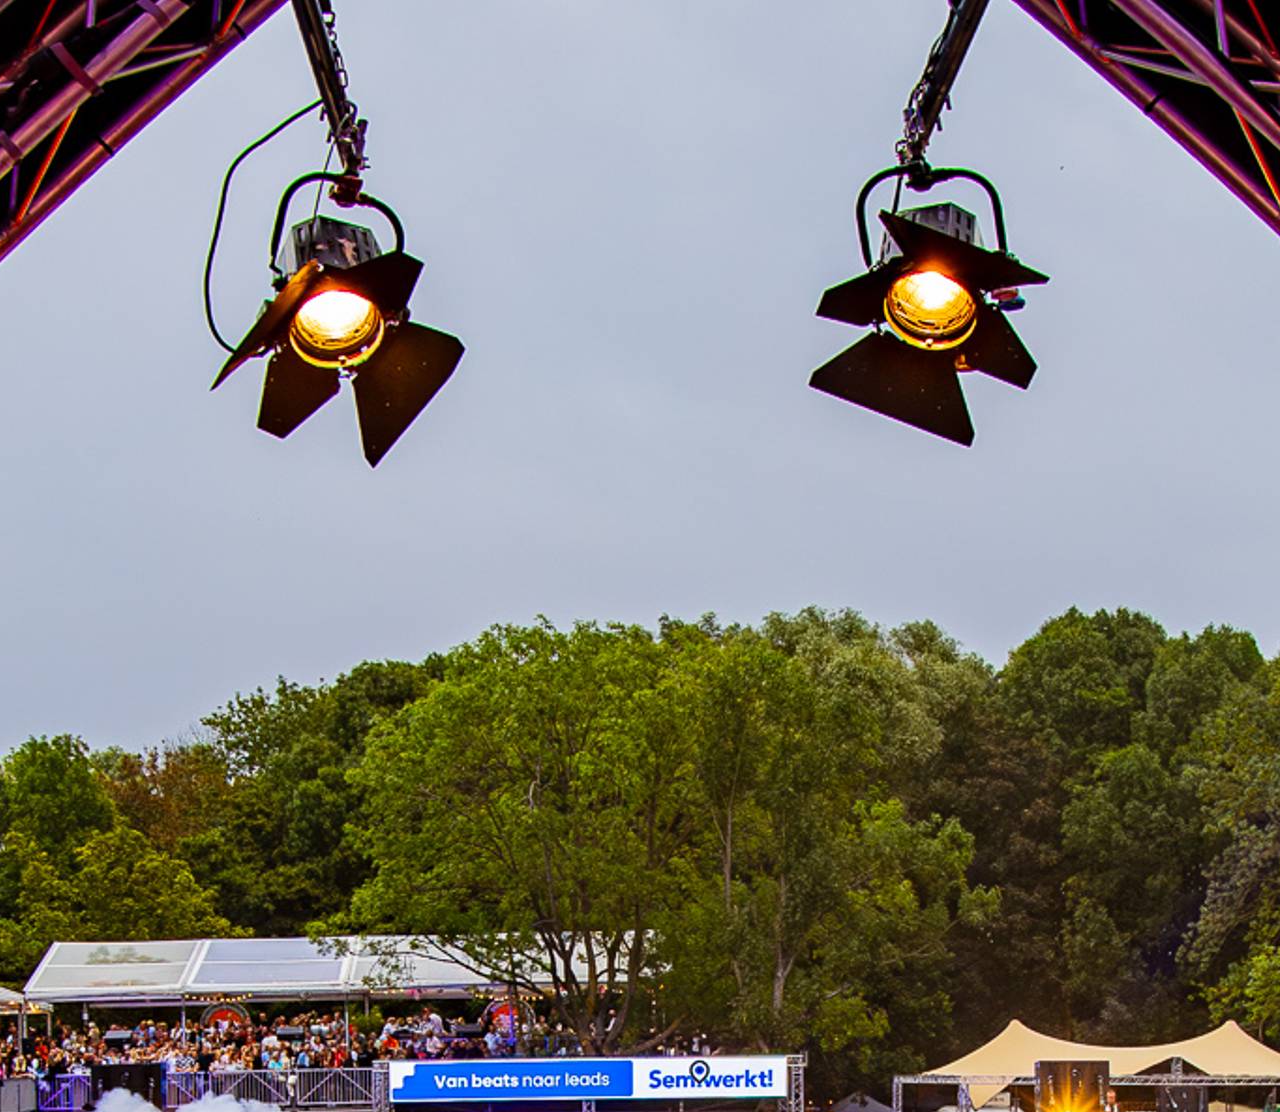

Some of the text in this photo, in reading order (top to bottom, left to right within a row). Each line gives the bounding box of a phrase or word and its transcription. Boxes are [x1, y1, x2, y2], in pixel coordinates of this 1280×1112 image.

[434, 1071, 610, 1089] Van beats naar leads
